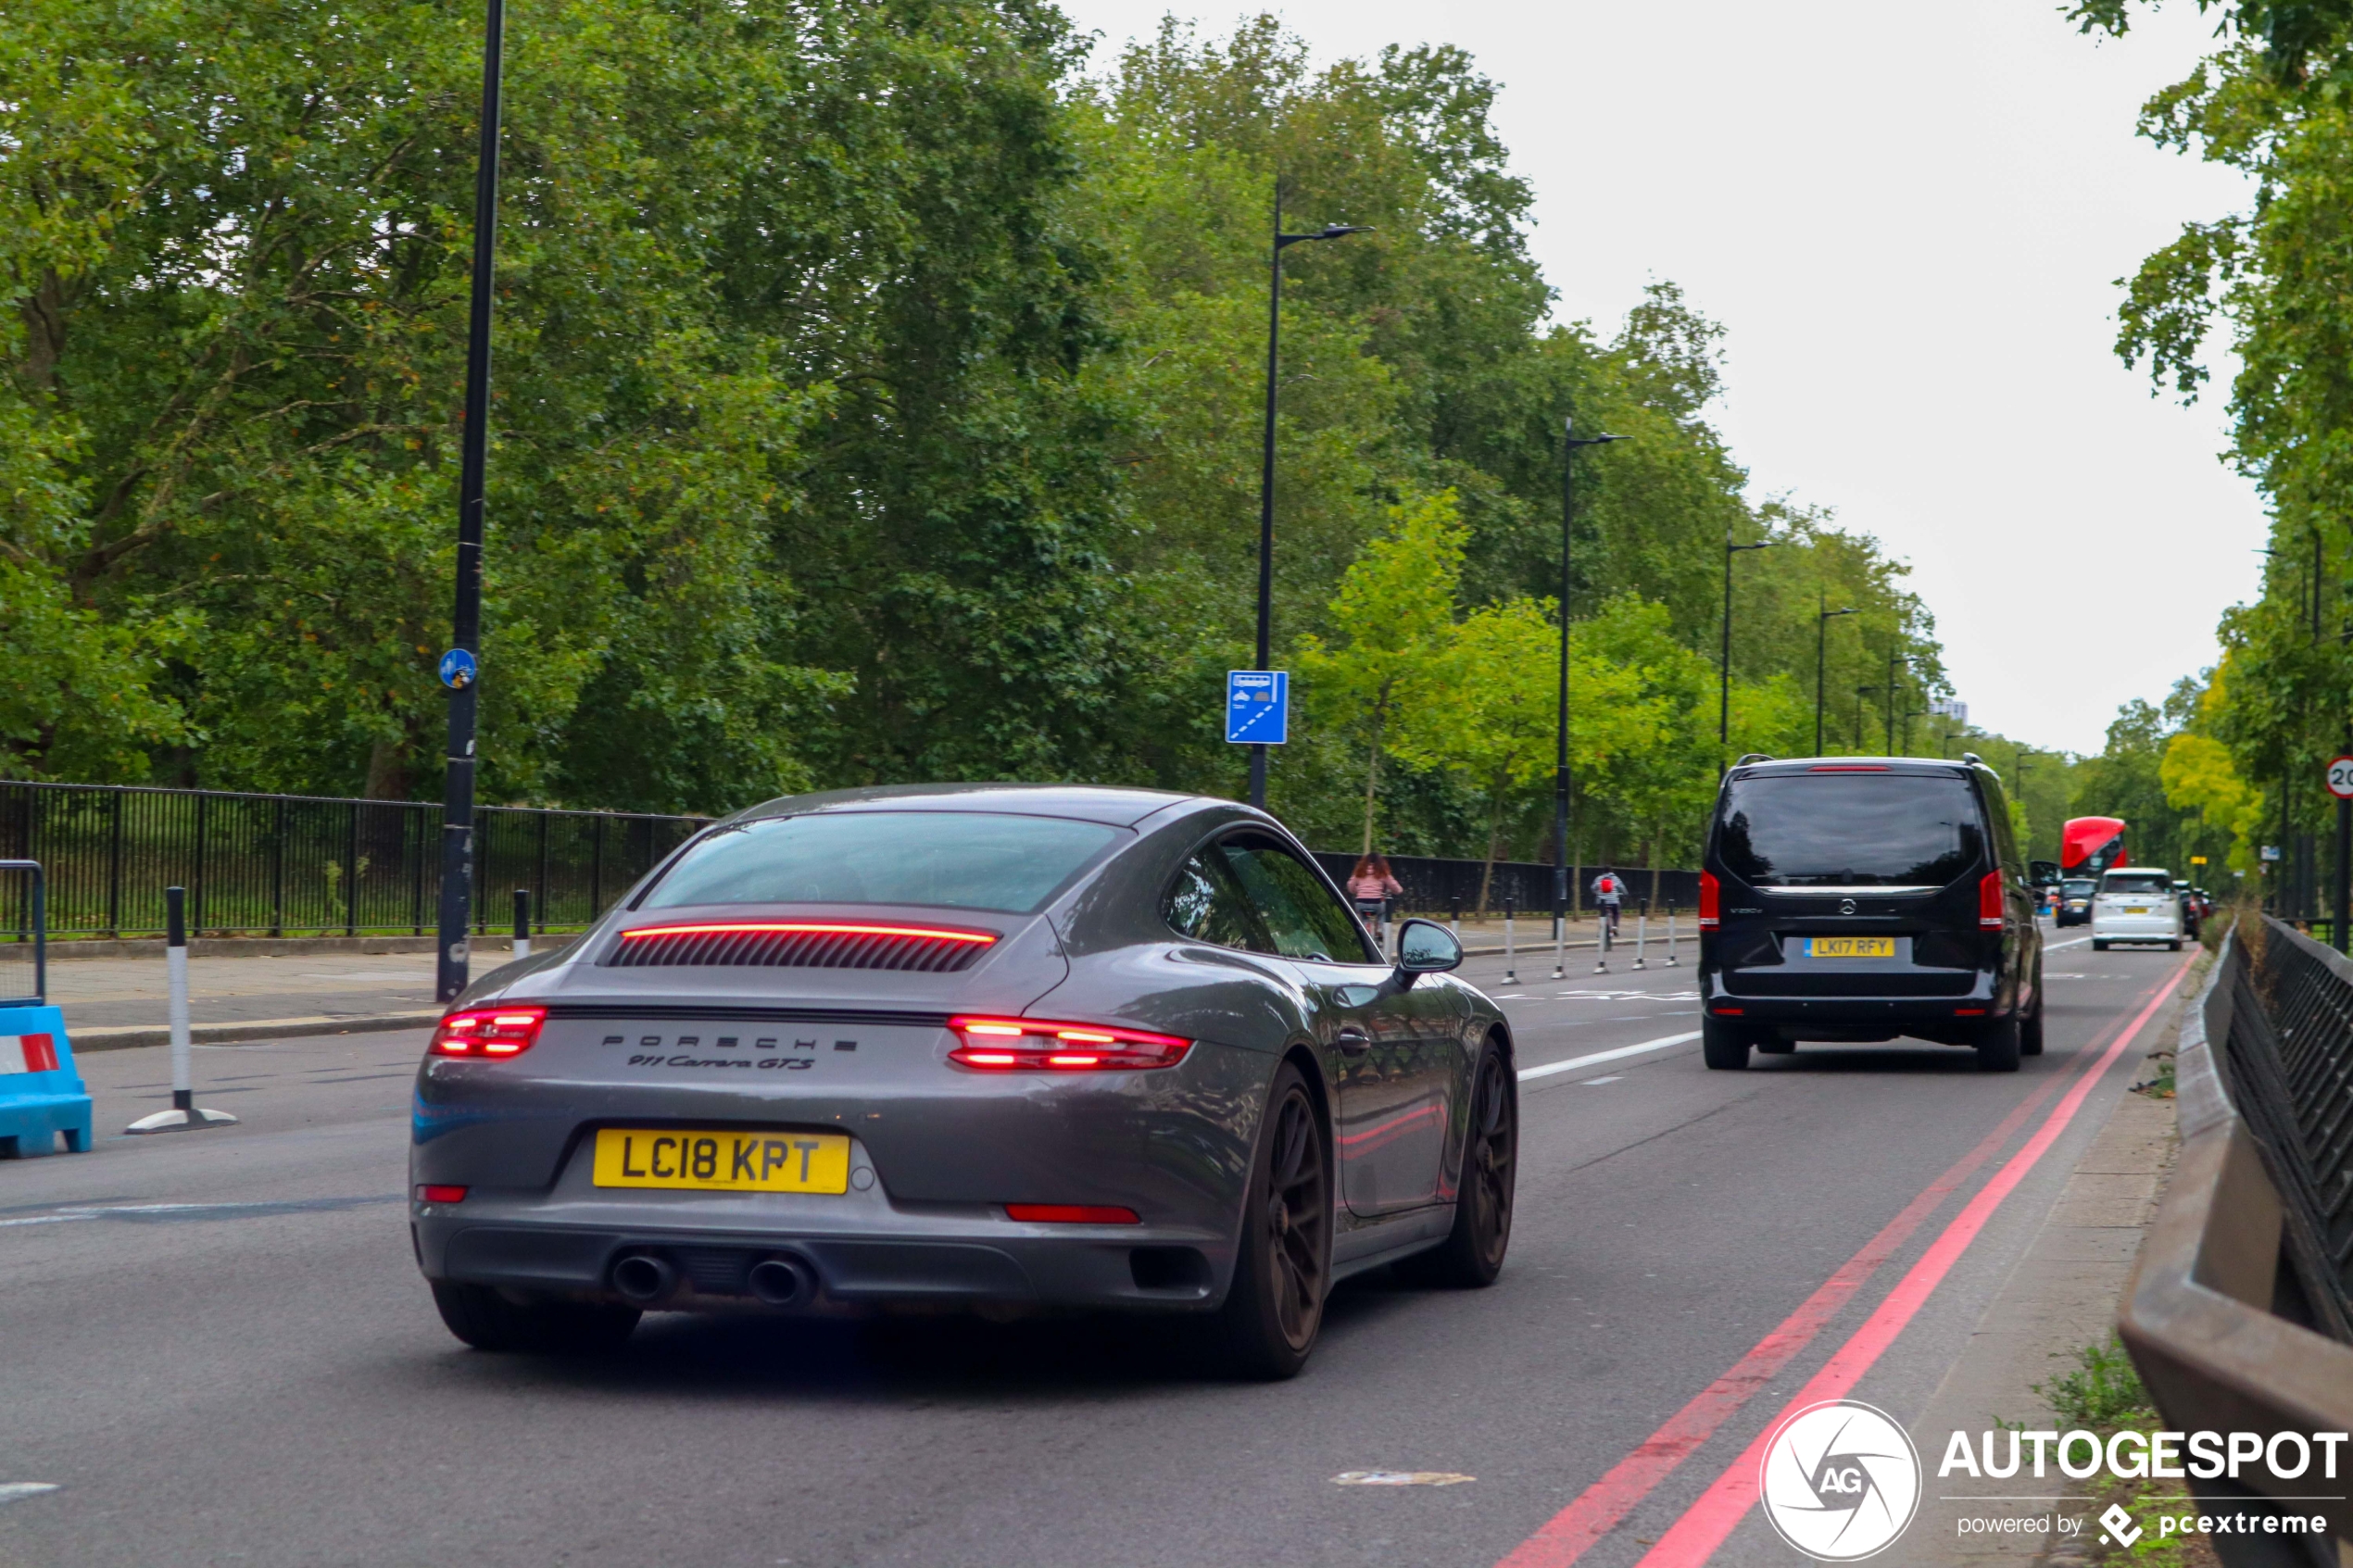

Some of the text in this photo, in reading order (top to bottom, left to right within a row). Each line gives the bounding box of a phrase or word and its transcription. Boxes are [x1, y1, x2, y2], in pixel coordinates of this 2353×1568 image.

[1818, 939, 1888, 955] LK17 RFY
[602, 1035, 857, 1051] PORSCHE
[627, 1054, 815, 1070] 911 Carrera GTS
[623, 1136, 819, 1183] LC18 KPT
